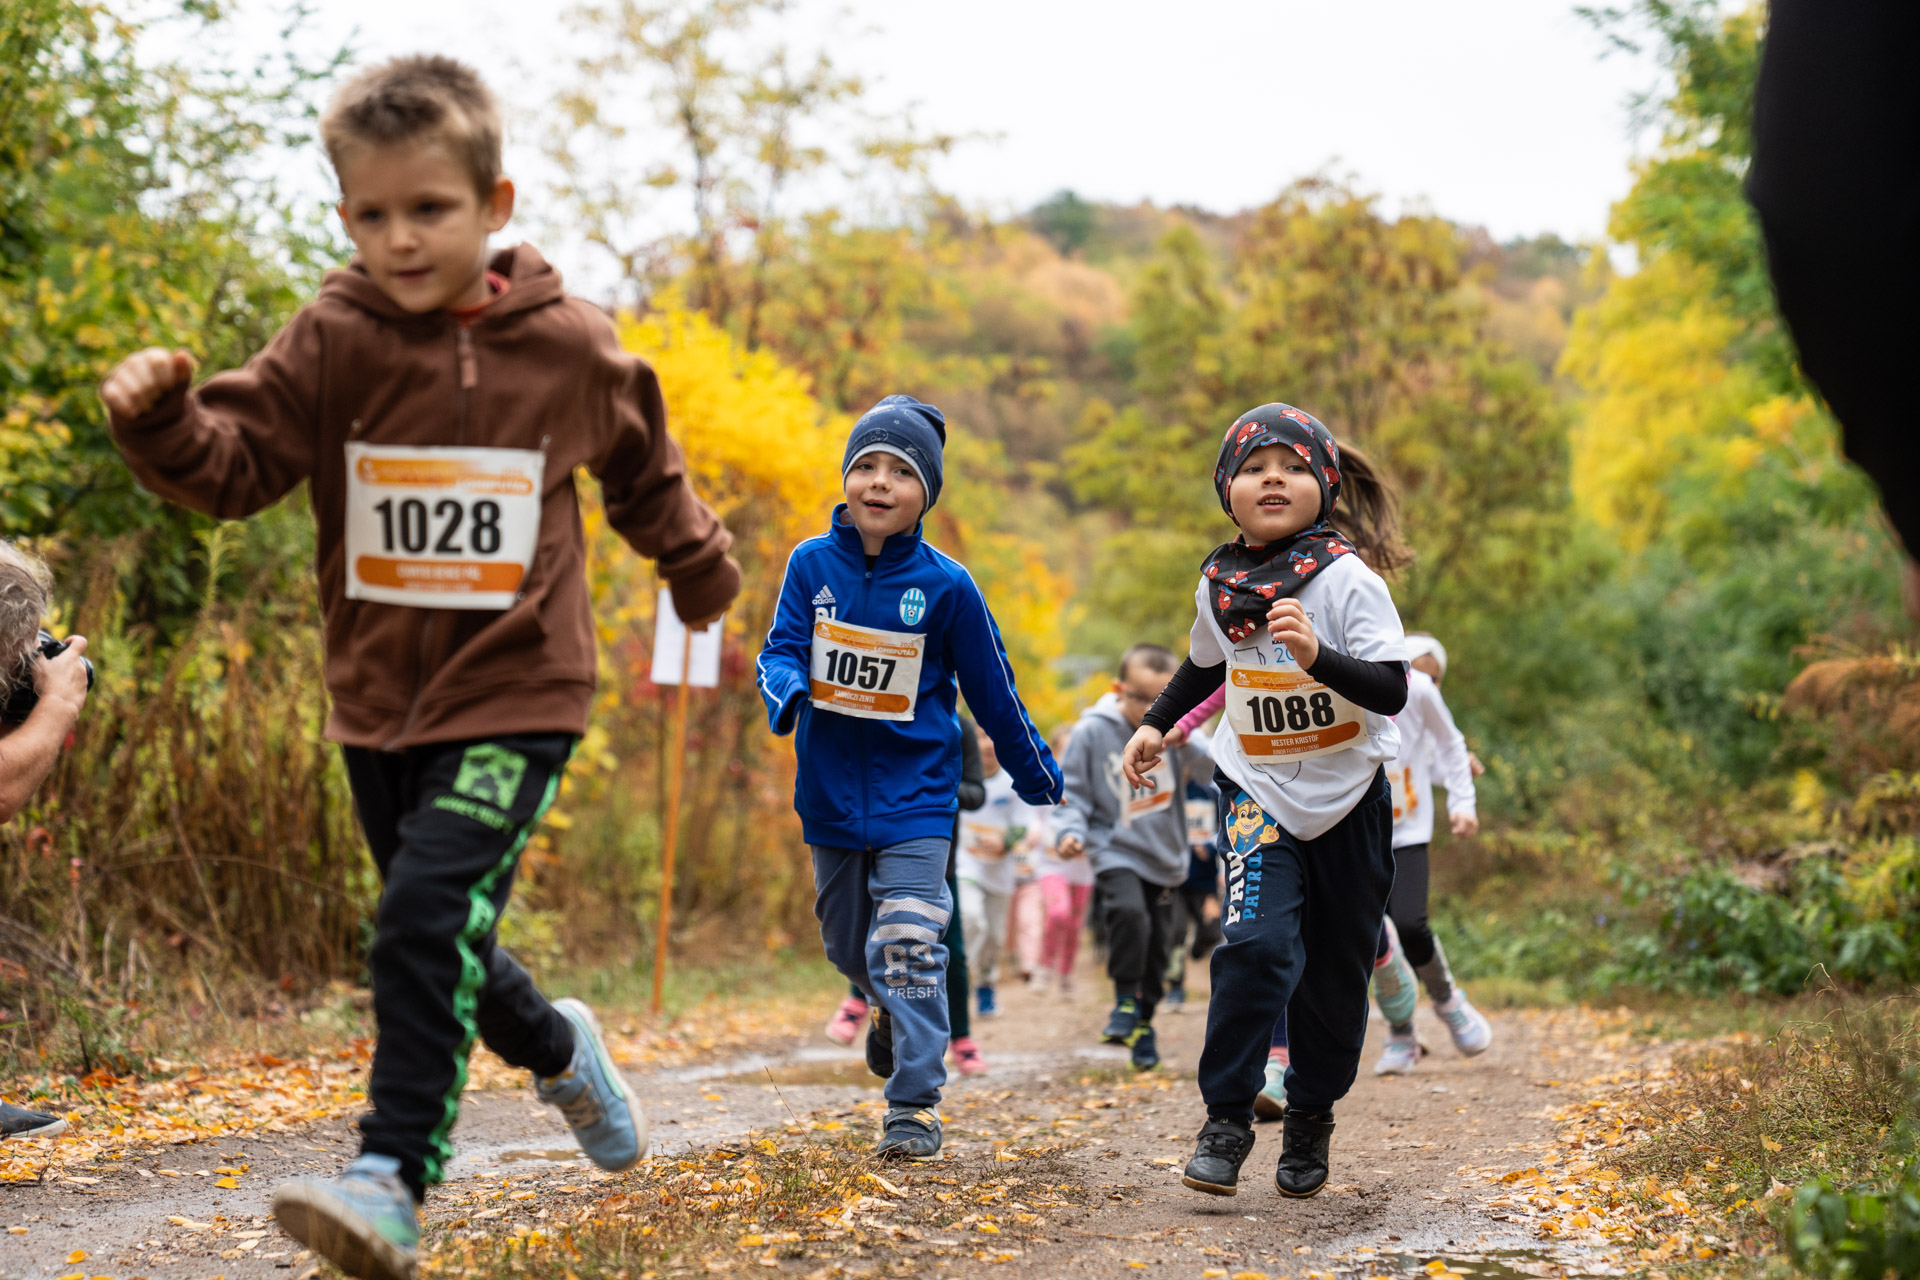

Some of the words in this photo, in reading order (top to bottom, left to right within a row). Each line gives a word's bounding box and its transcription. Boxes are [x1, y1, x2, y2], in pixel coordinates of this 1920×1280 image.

[374, 499, 501, 554] 1028
[812, 597, 836, 605] adidas
[826, 649, 896, 691] 1057
[859, 694, 876, 704] ZENTE
[1247, 692, 1335, 733] 1088
[1271, 738, 1294, 747] MESTER
[1294, 734, 1319, 745] KRISTÓF
[1225, 851, 1245, 926] PAW
[1243, 852, 1263, 920] PATROL
[883, 944, 938, 987] 82
[887, 986, 938, 1000] FRESH
